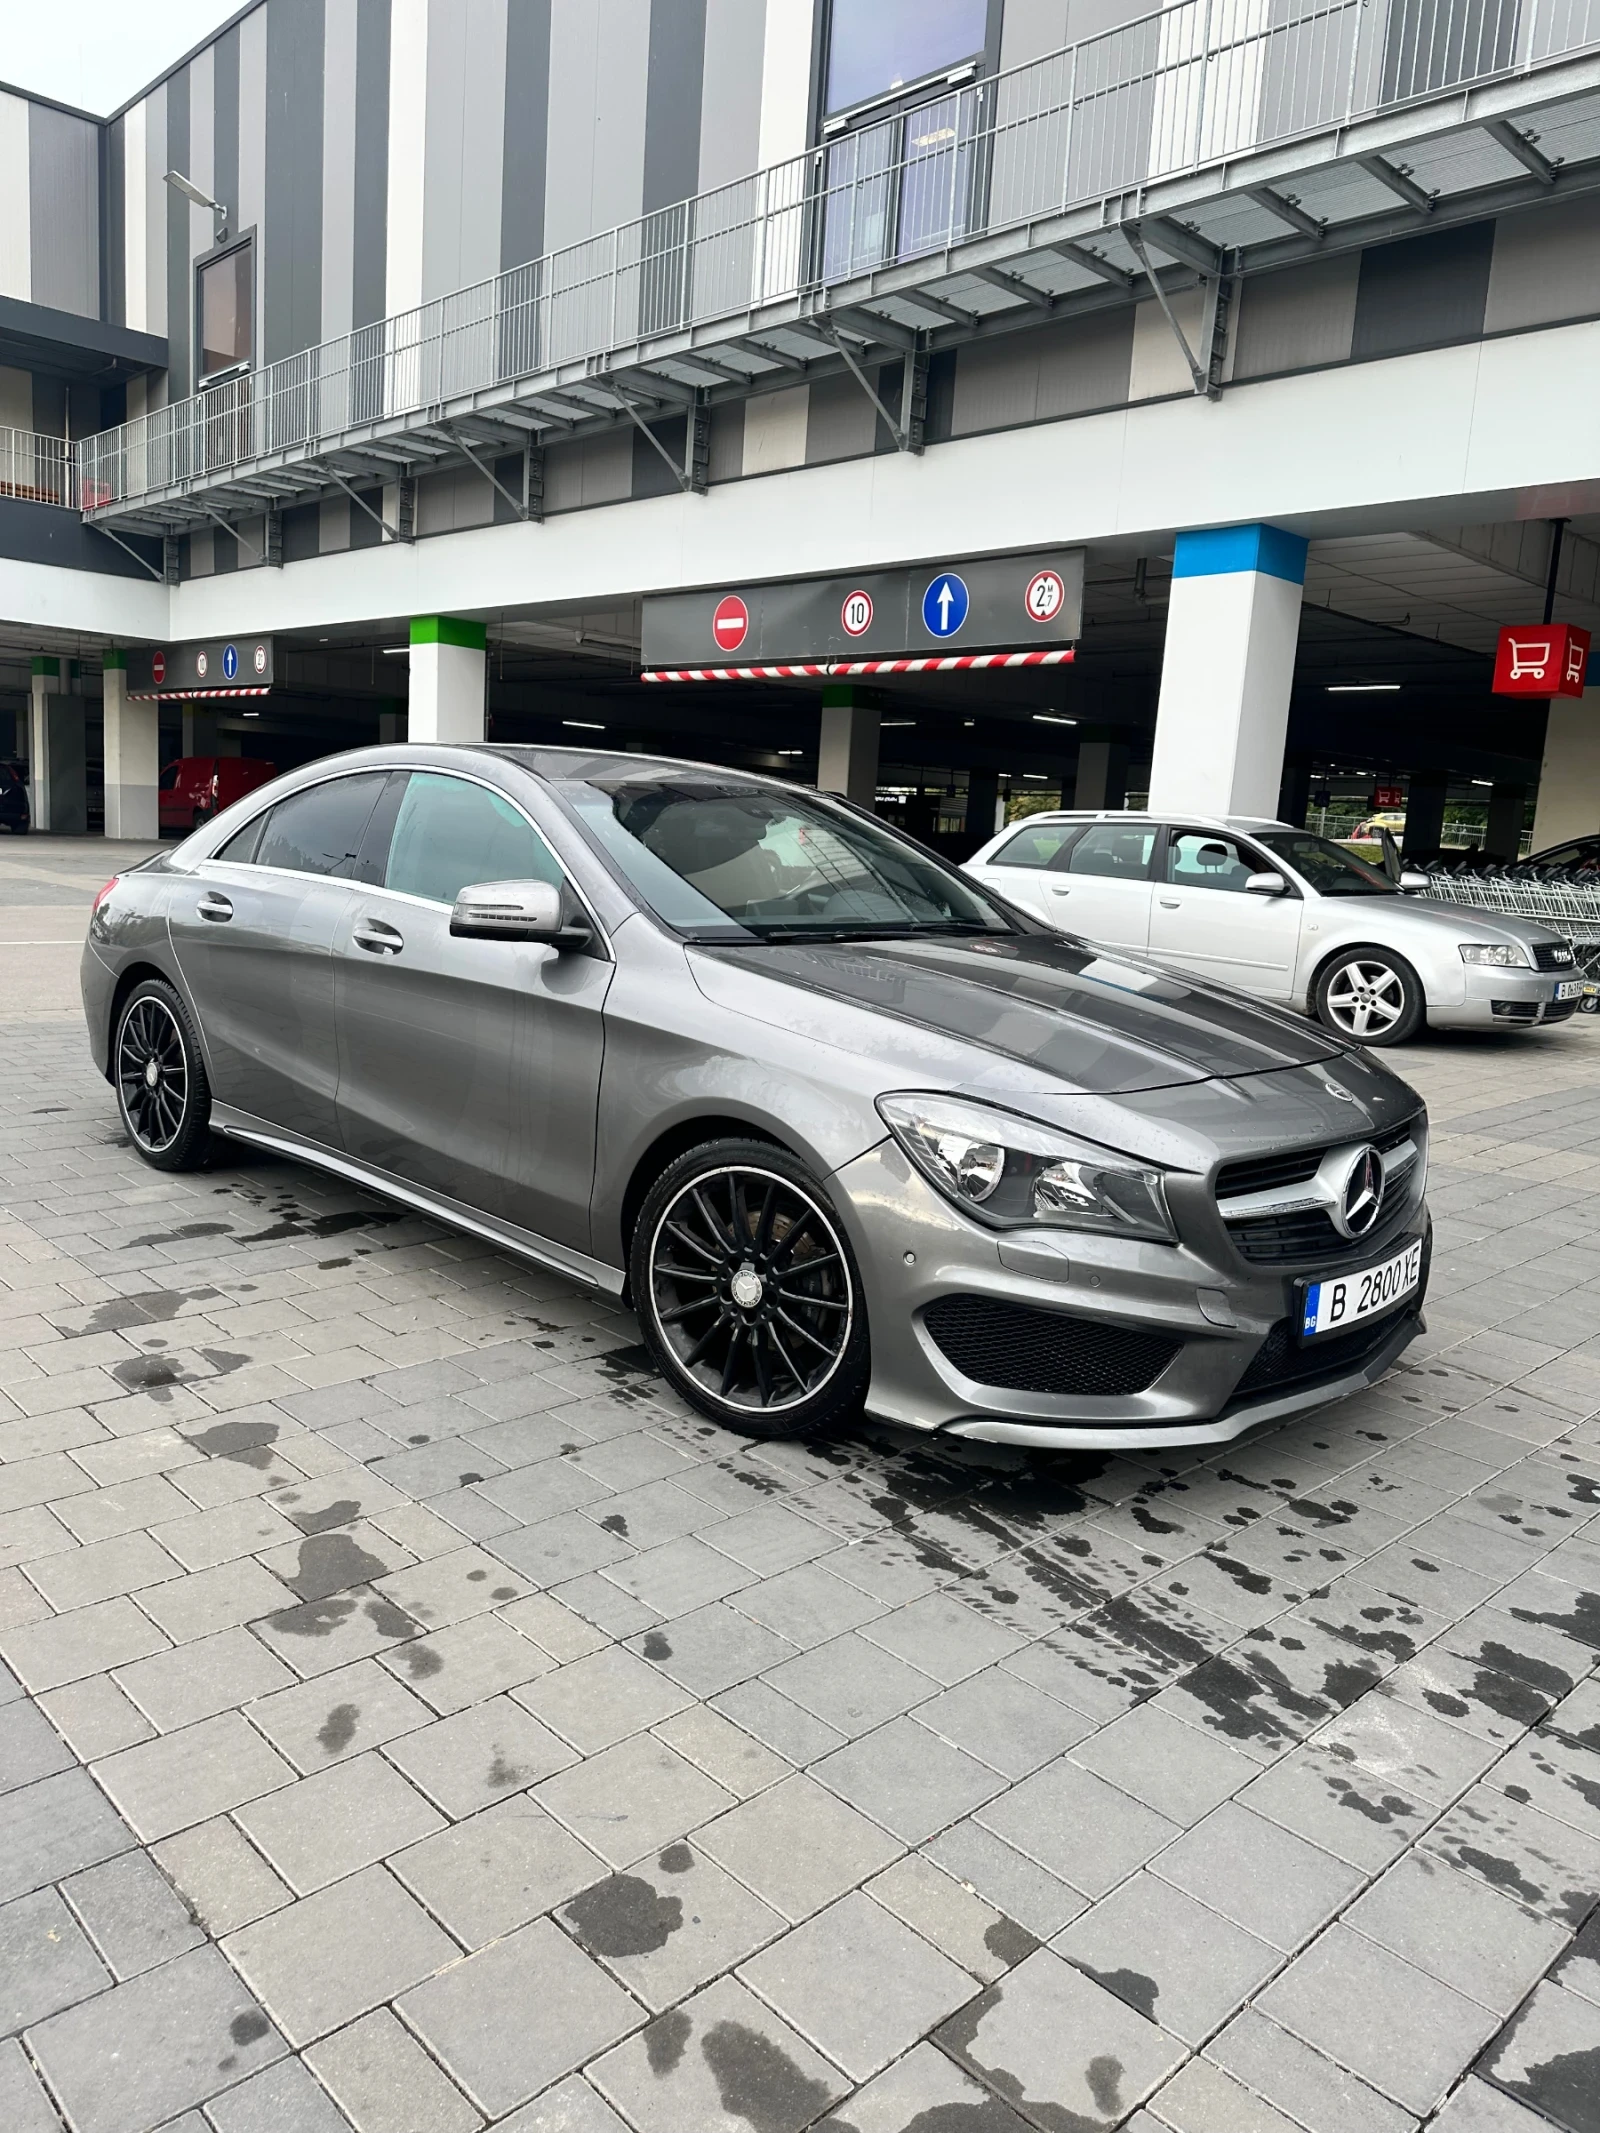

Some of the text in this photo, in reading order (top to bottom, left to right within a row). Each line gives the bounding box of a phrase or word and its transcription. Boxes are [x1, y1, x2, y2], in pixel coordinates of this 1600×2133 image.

[850, 602, 865, 625] 10
[1330, 1245, 1420, 1322] B 2800 XE
[1305, 1316, 1317, 1329] BG
